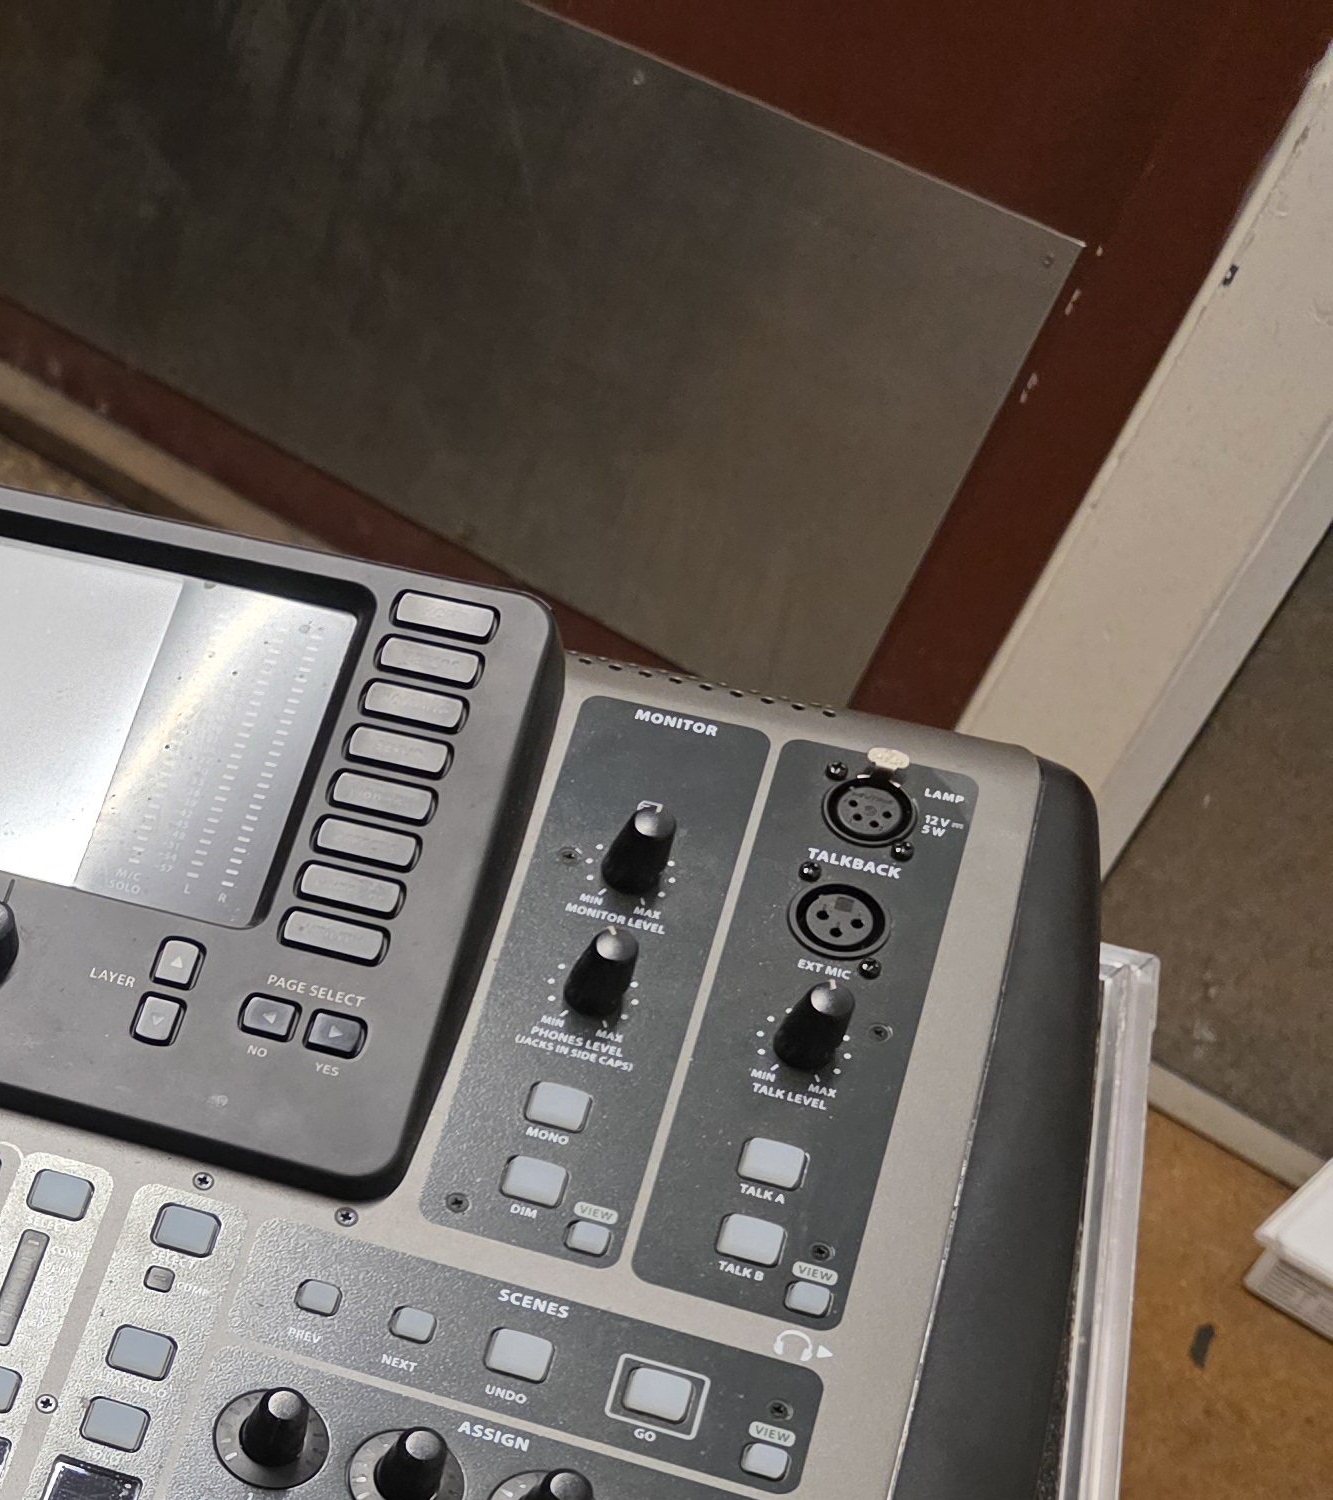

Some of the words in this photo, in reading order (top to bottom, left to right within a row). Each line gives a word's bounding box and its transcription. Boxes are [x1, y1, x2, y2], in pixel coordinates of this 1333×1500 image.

[634, 709, 719, 737] MONITOR
[924, 787, 965, 804] LAMP
[924, 814, 937, 826] 12
[937, 817, 951, 828] V
[921, 824, 931, 834] 5
[932, 827, 946, 838] W
[808, 847, 903, 879] TALKBACK
[107, 876, 142, 895] SOLO
[579, 893, 604, 906] MIN
[565, 902, 626, 925] MONITOR
[626, 917, 666, 935] LEVEL
[633, 906, 662, 920] MAX
[89, 967, 136, 988] LAYER
[797, 958, 824, 973] EXT
[824, 965, 852, 980] MIC
[266, 974, 306, 995] PAGE
[308, 985, 366, 1008] SELECT
[540, 1014, 566, 1028] MIN
[530, 1025, 584, 1047] PHONES
[584, 1039, 623, 1058] LEVEL
[595, 1029, 624, 1043] MAX
[246, 1044, 268, 1058] NO
[514, 1033, 555, 1051] (JACKS
[555, 1044, 570, 1056] IN
[570, 1048, 597, 1063] SIDE
[598, 1055, 634, 1073] CAPS)
[314, 1061, 340, 1077] YES
[750, 1068, 776, 1083] MIN
[752, 1082, 786, 1100] TALK
[786, 1091, 828, 1111] LEVEL
[808, 1083, 837, 1099] MAX
[525, 1126, 570, 1146] MONO
[739, 1182, 773, 1201] TALK
[773, 1193, 786, 1205] A
[509, 1203, 539, 1219] DIM
[579, 1204, 614, 1222] VIEW
[718, 1260, 752, 1279] TALK
[753, 1270, 765, 1282] B
[798, 1264, 834, 1282] VIEW
[497, 1288, 570, 1319] SCENES
[286, 1327, 322, 1344] PREV
[380, 1354, 418, 1373] NEXT
[484, 1384, 528, 1405] UNDO
[457, 1421, 530, 1452] ASSIGN
[633, 1428, 657, 1442] GO
[755, 1425, 791, 1443] VIEW
